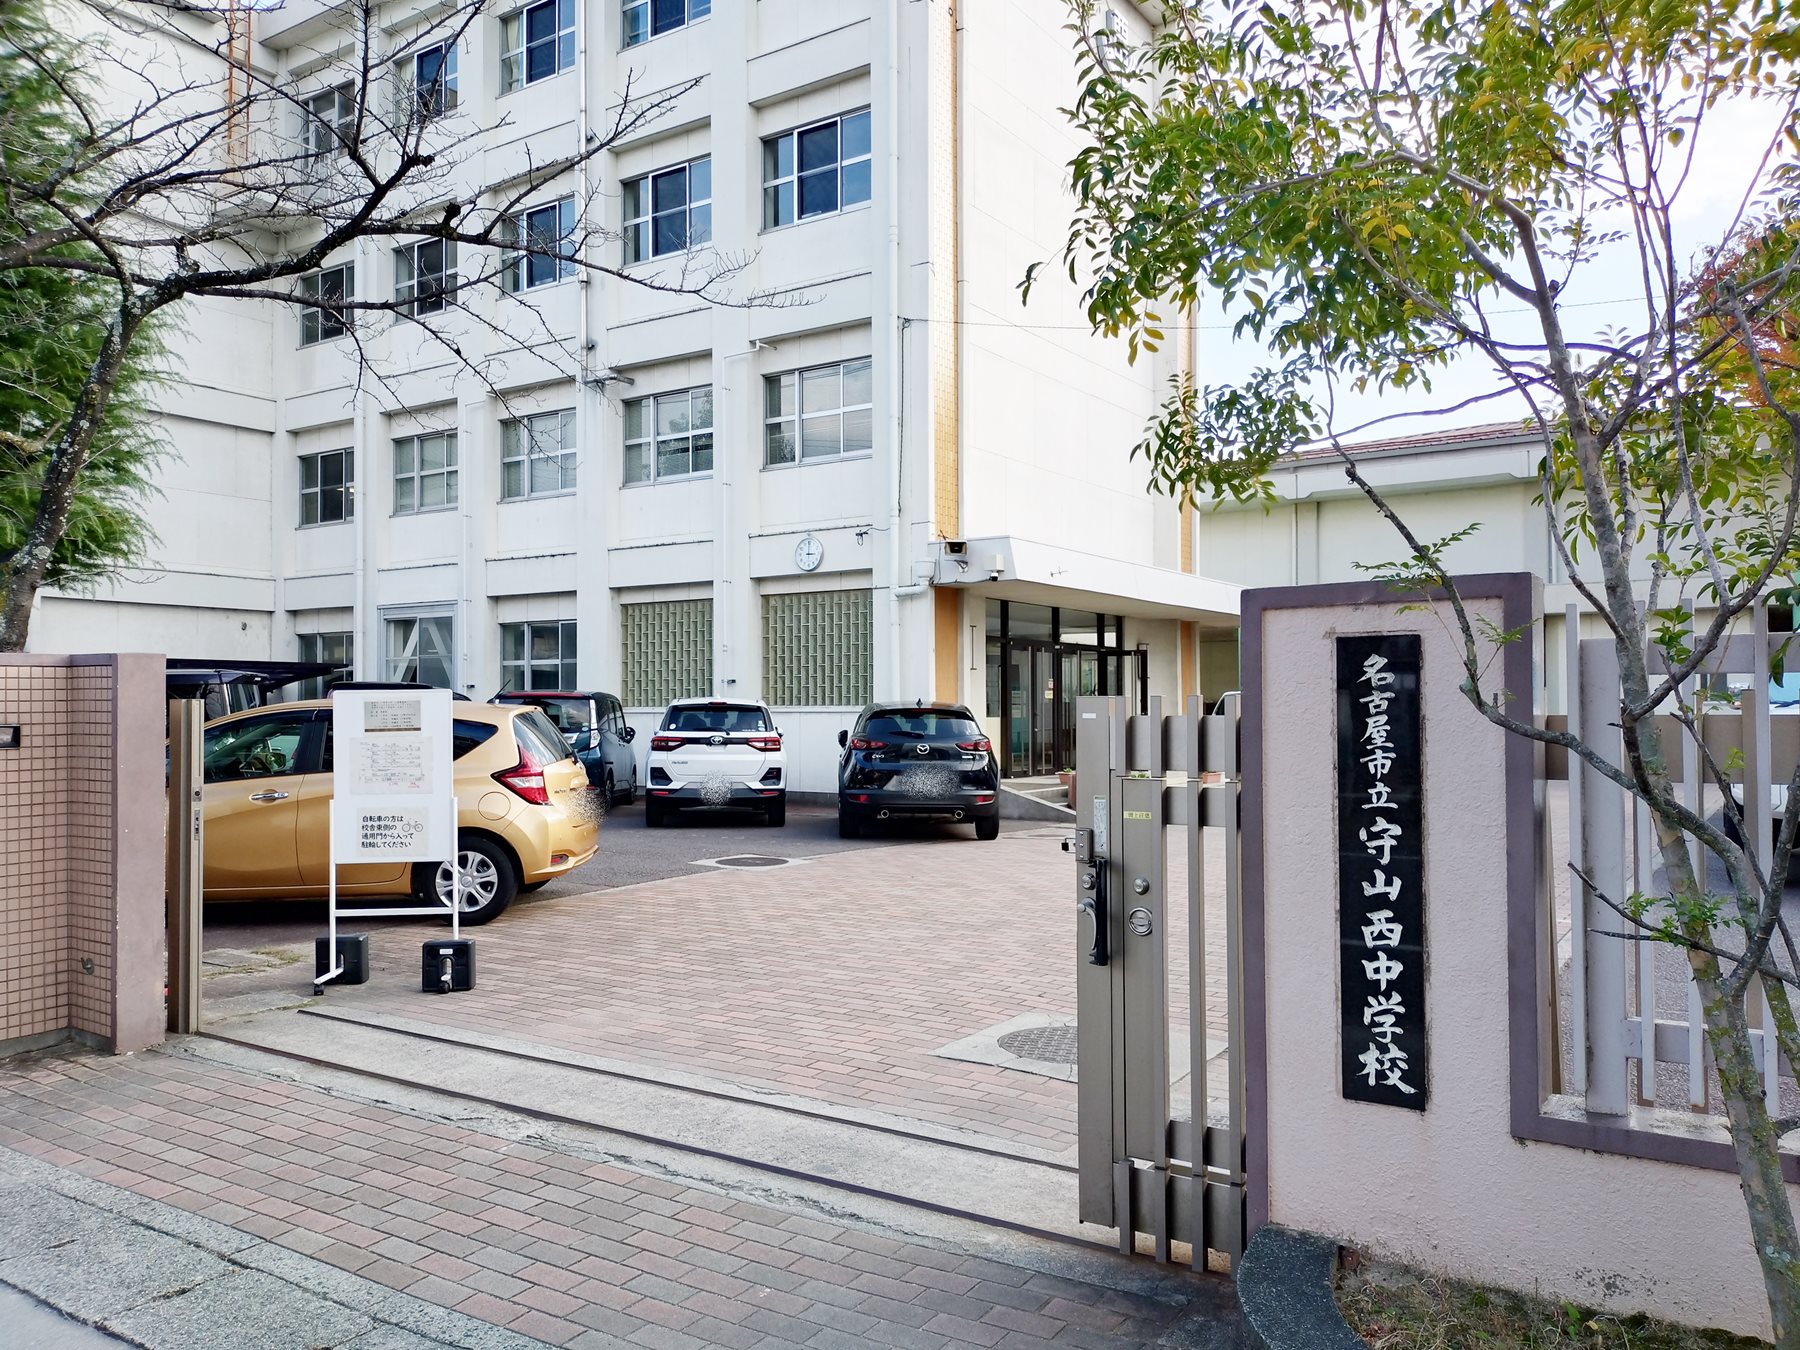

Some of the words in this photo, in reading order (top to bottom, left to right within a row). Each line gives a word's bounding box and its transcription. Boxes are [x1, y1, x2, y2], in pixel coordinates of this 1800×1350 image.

[362, 815, 404, 823] 自転車の方は
[361, 824, 398, 832] 校舎東側の
[361, 832, 414, 840] 通用門から入って
[361, 841, 412, 849] 駐輪してください
[1356, 653, 1420, 1094] 名古屋市立守山西中学校
